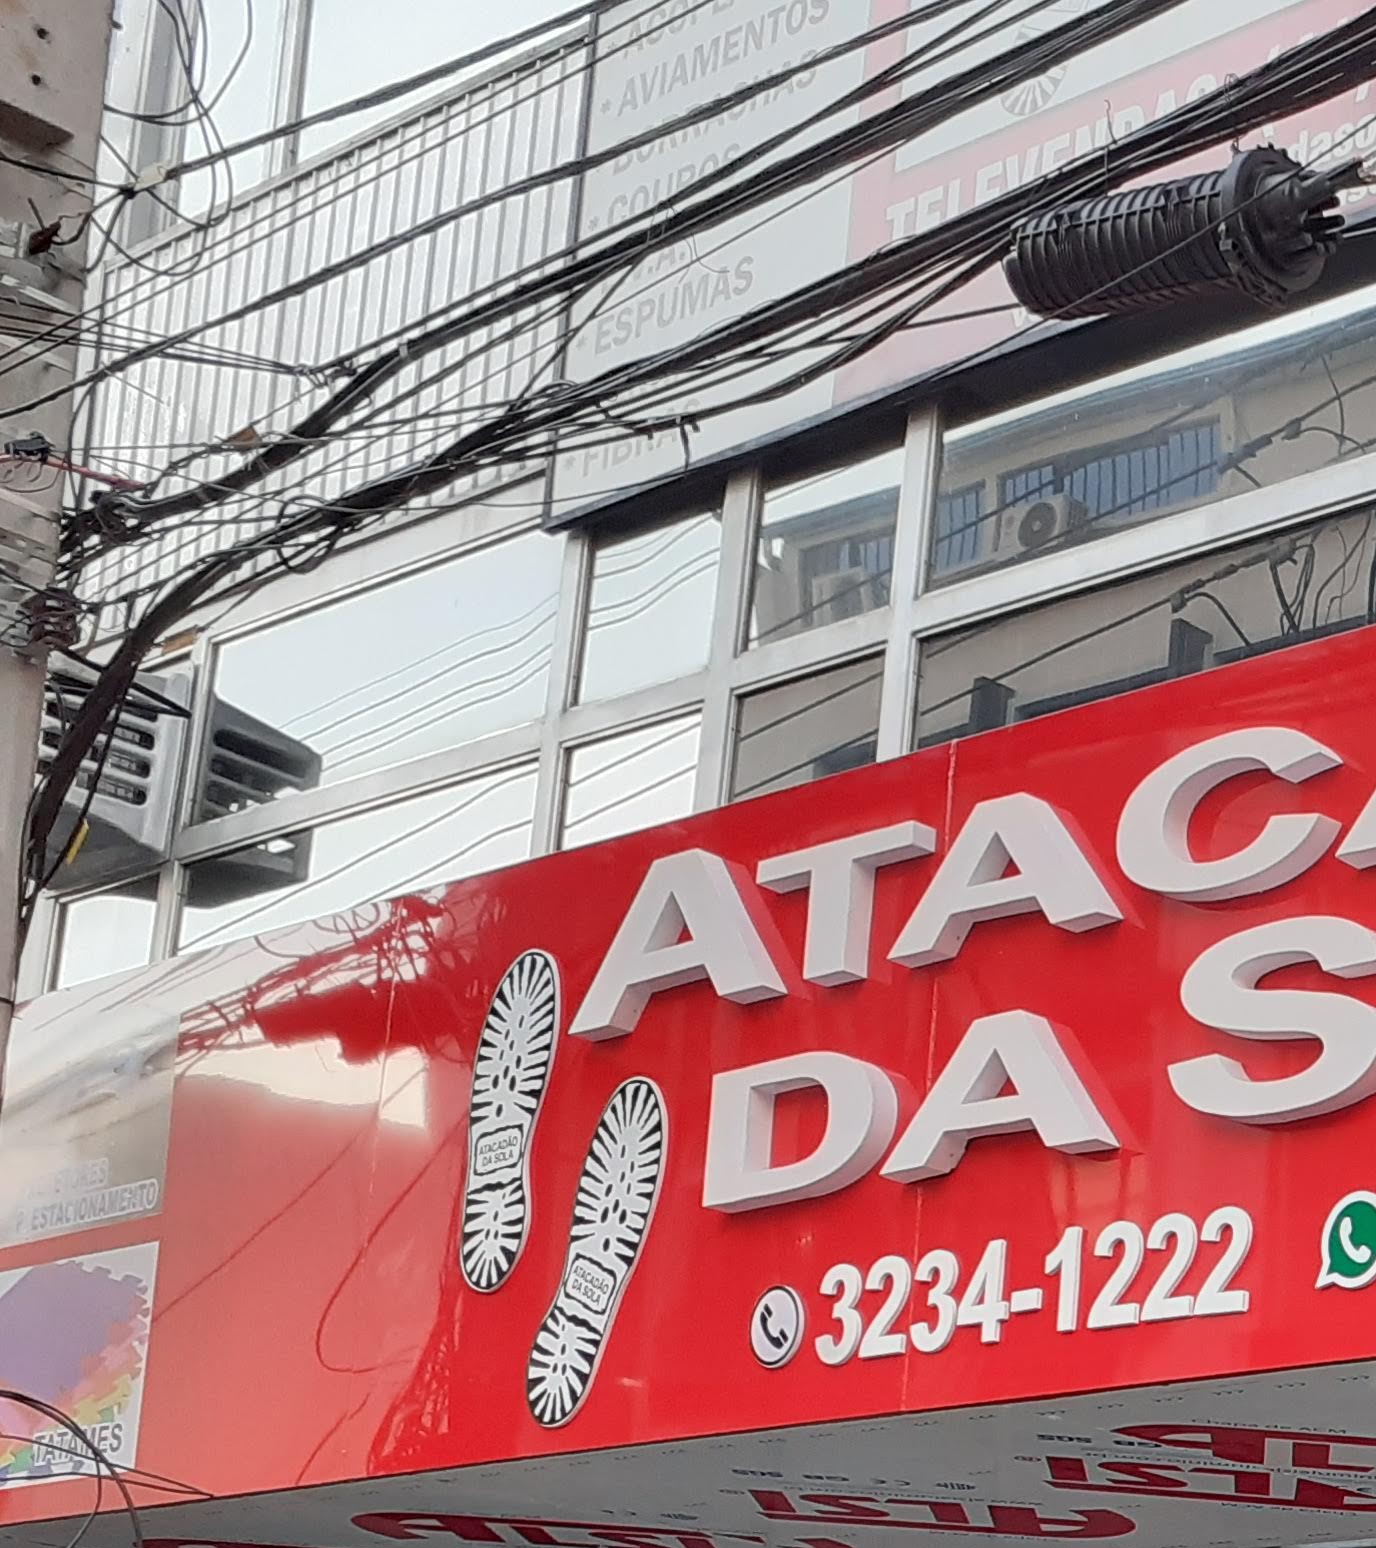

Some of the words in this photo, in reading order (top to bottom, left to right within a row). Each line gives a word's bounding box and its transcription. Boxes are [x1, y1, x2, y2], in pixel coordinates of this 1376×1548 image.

[616, 0, 830, 117] AVIAMENTOS
[595, 255, 755, 355] ESPUMAS
[702, 1008, 1122, 1214] DA
[814, 1206, 1255, 1366] 3234-1222
[34, 1422, 123, 1466] TATAMES
[748, 1488, 1137, 1539] ALSI
